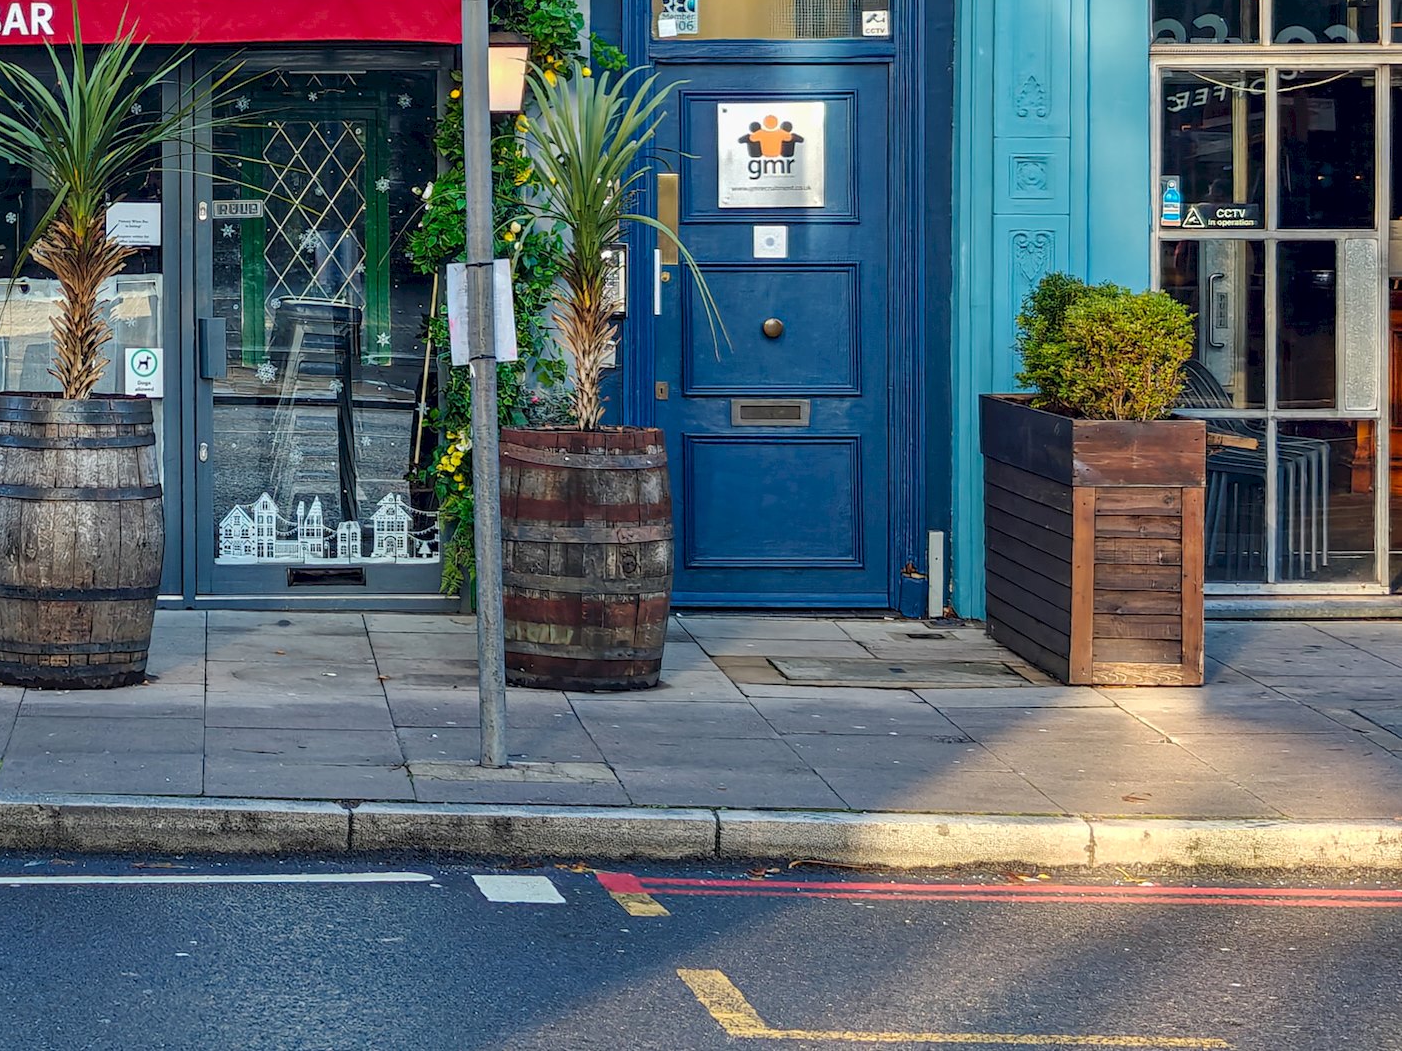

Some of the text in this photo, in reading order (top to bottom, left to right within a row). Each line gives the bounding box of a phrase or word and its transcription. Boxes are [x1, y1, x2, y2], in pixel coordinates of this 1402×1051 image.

[747, 158, 795, 180] gmr
[1216, 208, 1246, 218] CCTV
[1216, 219, 1255, 227] operation
